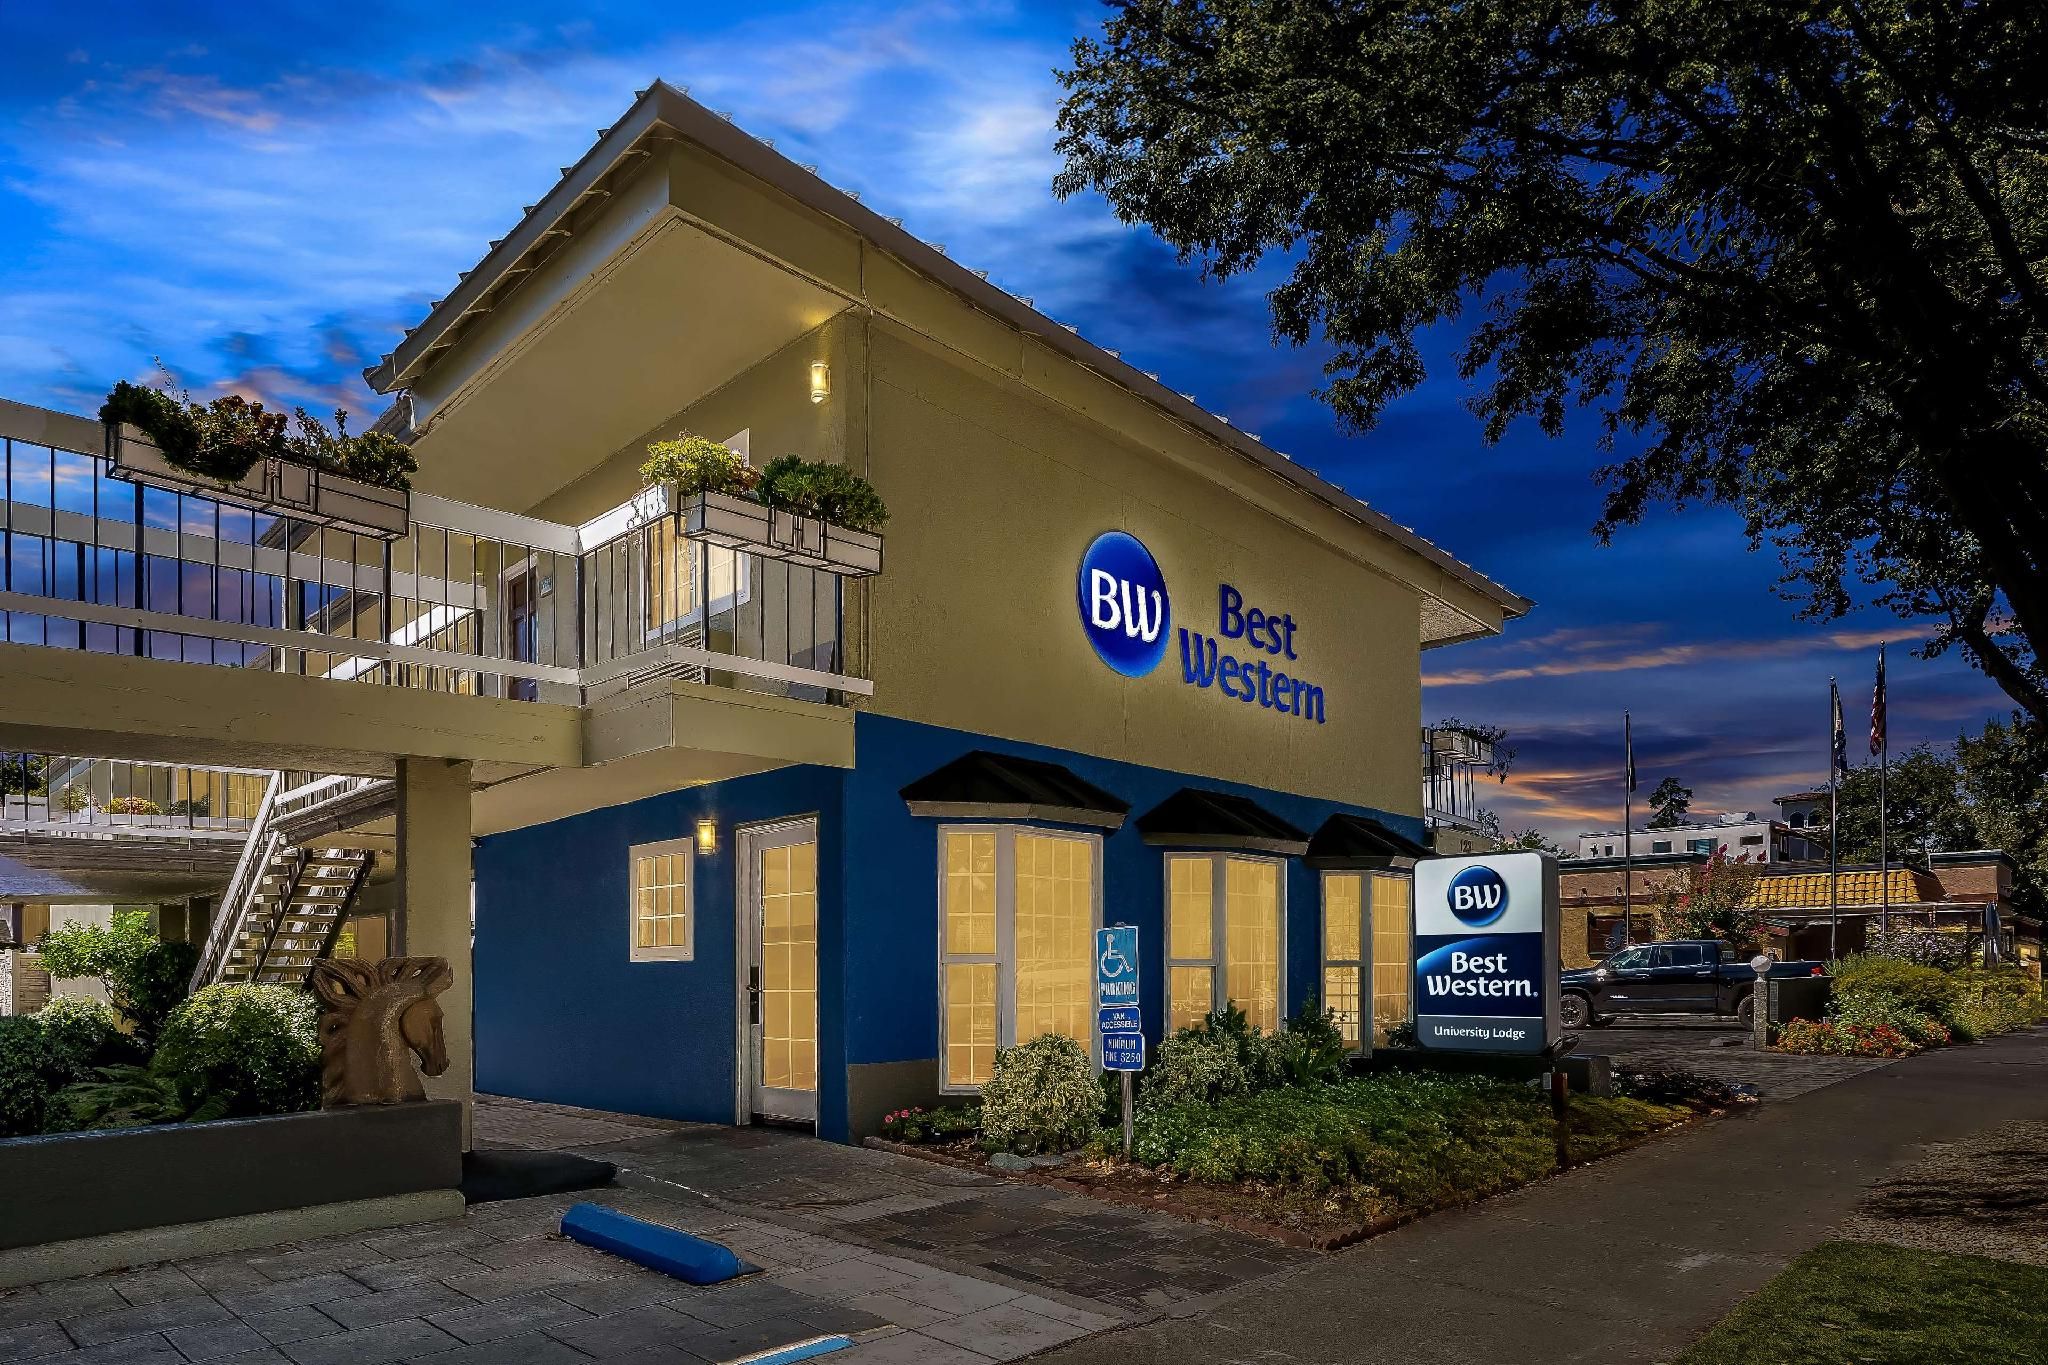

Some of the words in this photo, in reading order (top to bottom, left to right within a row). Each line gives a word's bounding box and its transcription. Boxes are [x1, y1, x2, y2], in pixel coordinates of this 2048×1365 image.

[1091, 568, 1162, 642] BW
[1219, 583, 1298, 661] Best
[1178, 627, 1326, 724] Western
[1454, 884, 1501, 910] BW
[1451, 951, 1508, 974] Best
[1101, 982, 1136, 996] PARKING
[1101, 1020, 1138, 1030] ACCESSIBLE
[1112, 1012, 1125, 1020] VAN
[1434, 1025, 1490, 1039] University
[1493, 1026, 1526, 1041] Lodge
[1108, 1039, 1136, 1050] MINIMUM
